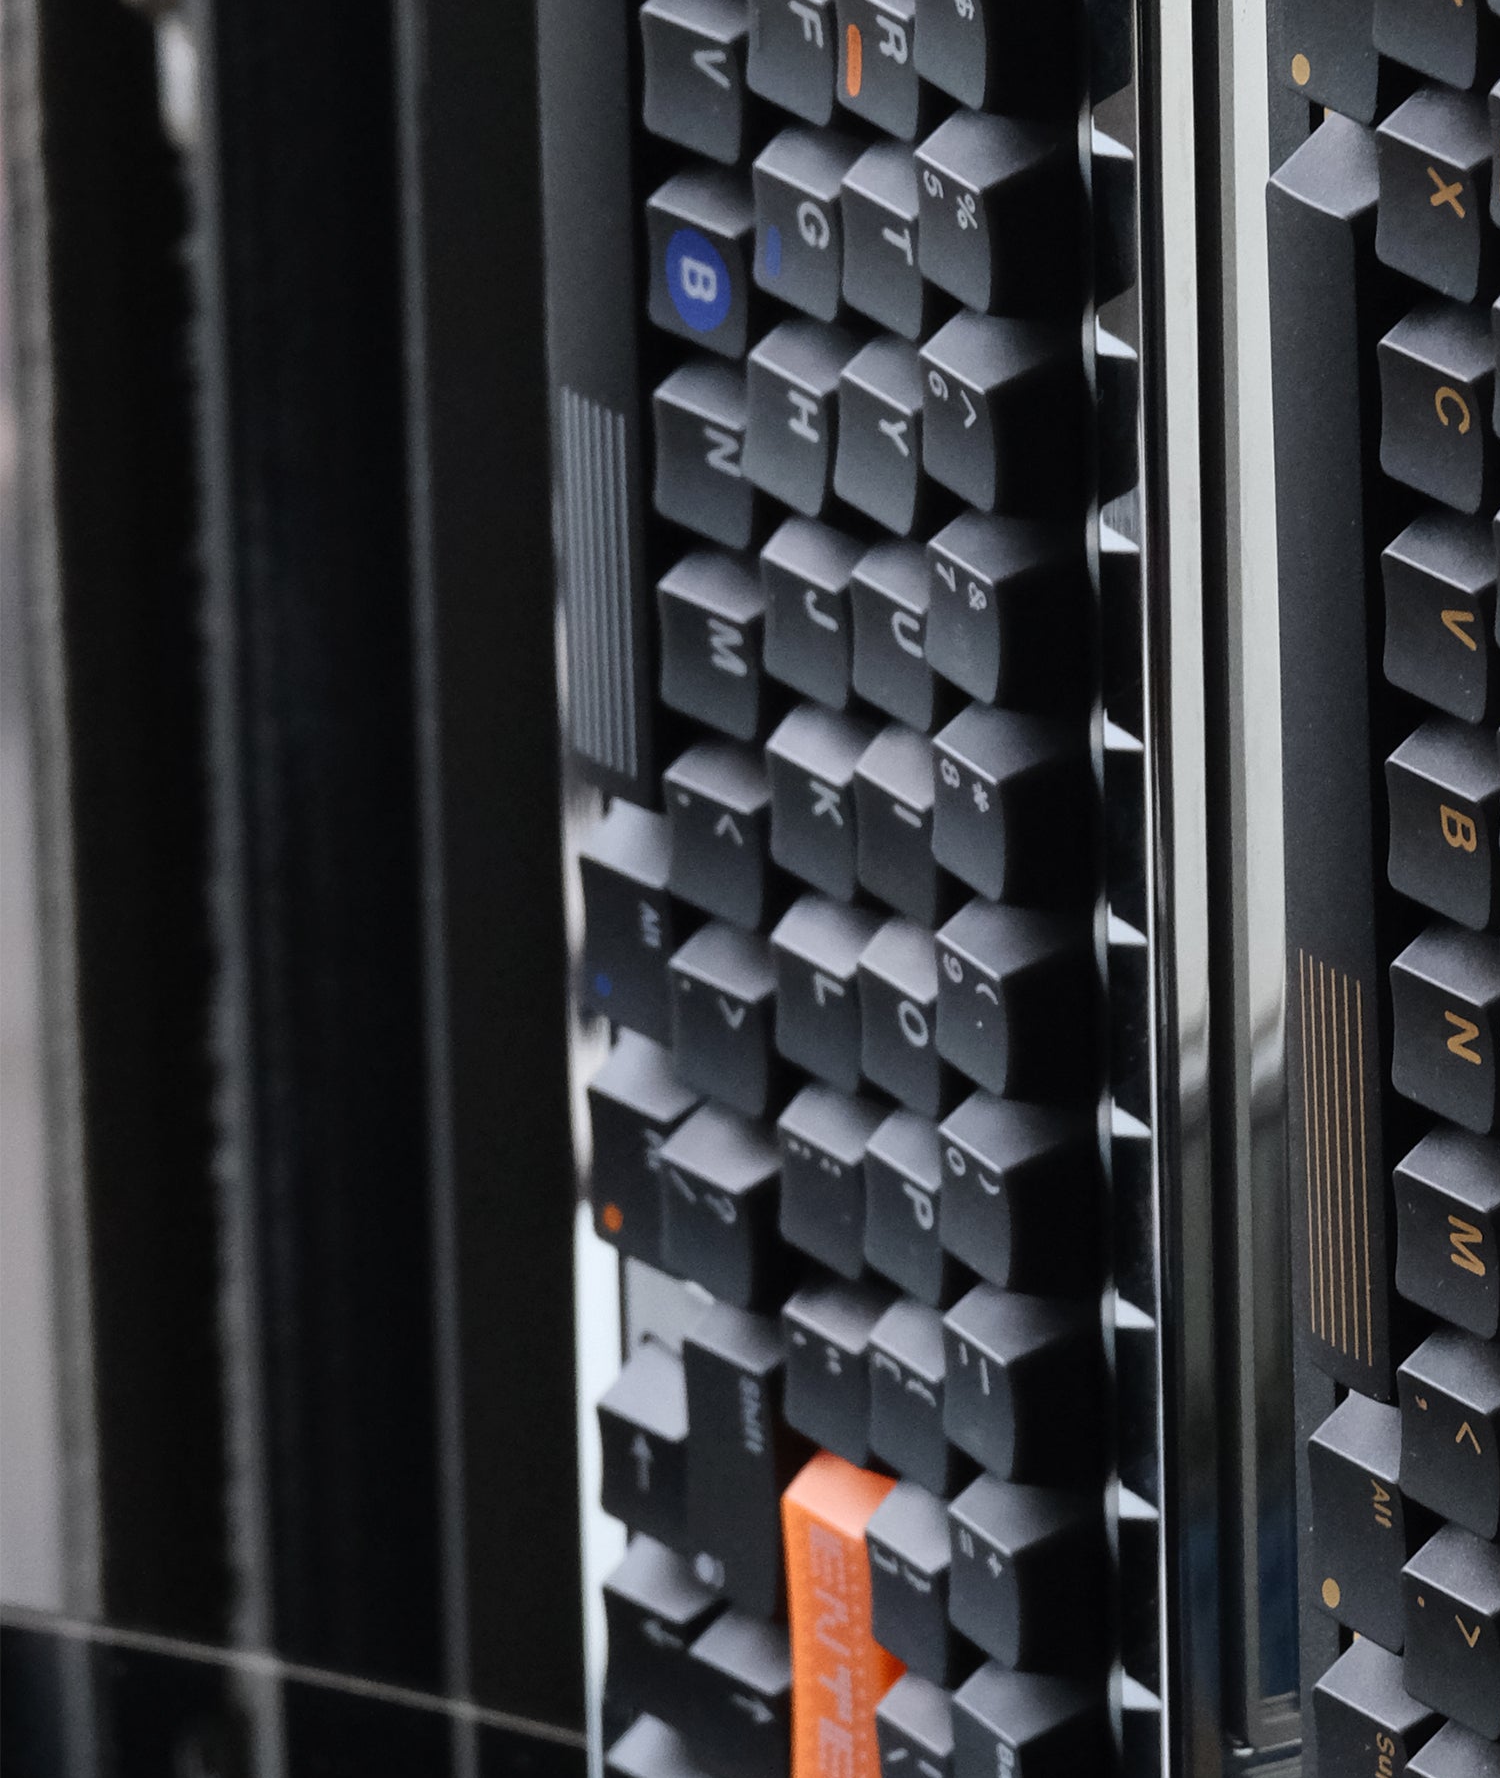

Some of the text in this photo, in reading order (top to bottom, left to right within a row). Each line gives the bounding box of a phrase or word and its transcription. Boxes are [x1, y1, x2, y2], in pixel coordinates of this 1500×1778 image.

[790, 1, 823, 48] F
[876, 15, 907, 64] R
[693, 50, 730, 88] V
[924, 171, 943, 198] 5
[1428, 168, 1465, 218] X
[797, 202, 829, 249] G
[957, 194, 977, 229] %
[883, 228, 913, 265] T
[682, 257, 717, 302] B
[929, 371, 948, 400] 6
[789, 391, 819, 442] H
[1435, 387, 1470, 434] C
[705, 426, 741, 477] N
[879, 419, 908, 456] Y
[937, 563, 955, 591] 7
[968, 582, 986, 610] &
[805, 590, 838, 631] J
[1441, 610, 1476, 651] V
[709, 620, 747, 676] M
[892, 612, 923, 658] U
[941, 759, 959, 787] 8
[811, 782, 842, 824] K
[895, 805, 921, 827] I
[1440, 805, 1476, 852] B
[815, 974, 843, 1002] L
[943, 954, 962, 982] 9
[898, 1001, 928, 1047] O
[1445, 1011, 1481, 1064] N
[904, 1184, 933, 1229] P
[1448, 1216, 1485, 1276] M
[1456, 1422, 1481, 1454] <
[1372, 1480, 1391, 1527] Alt
[1455, 1615, 1480, 1647] >
